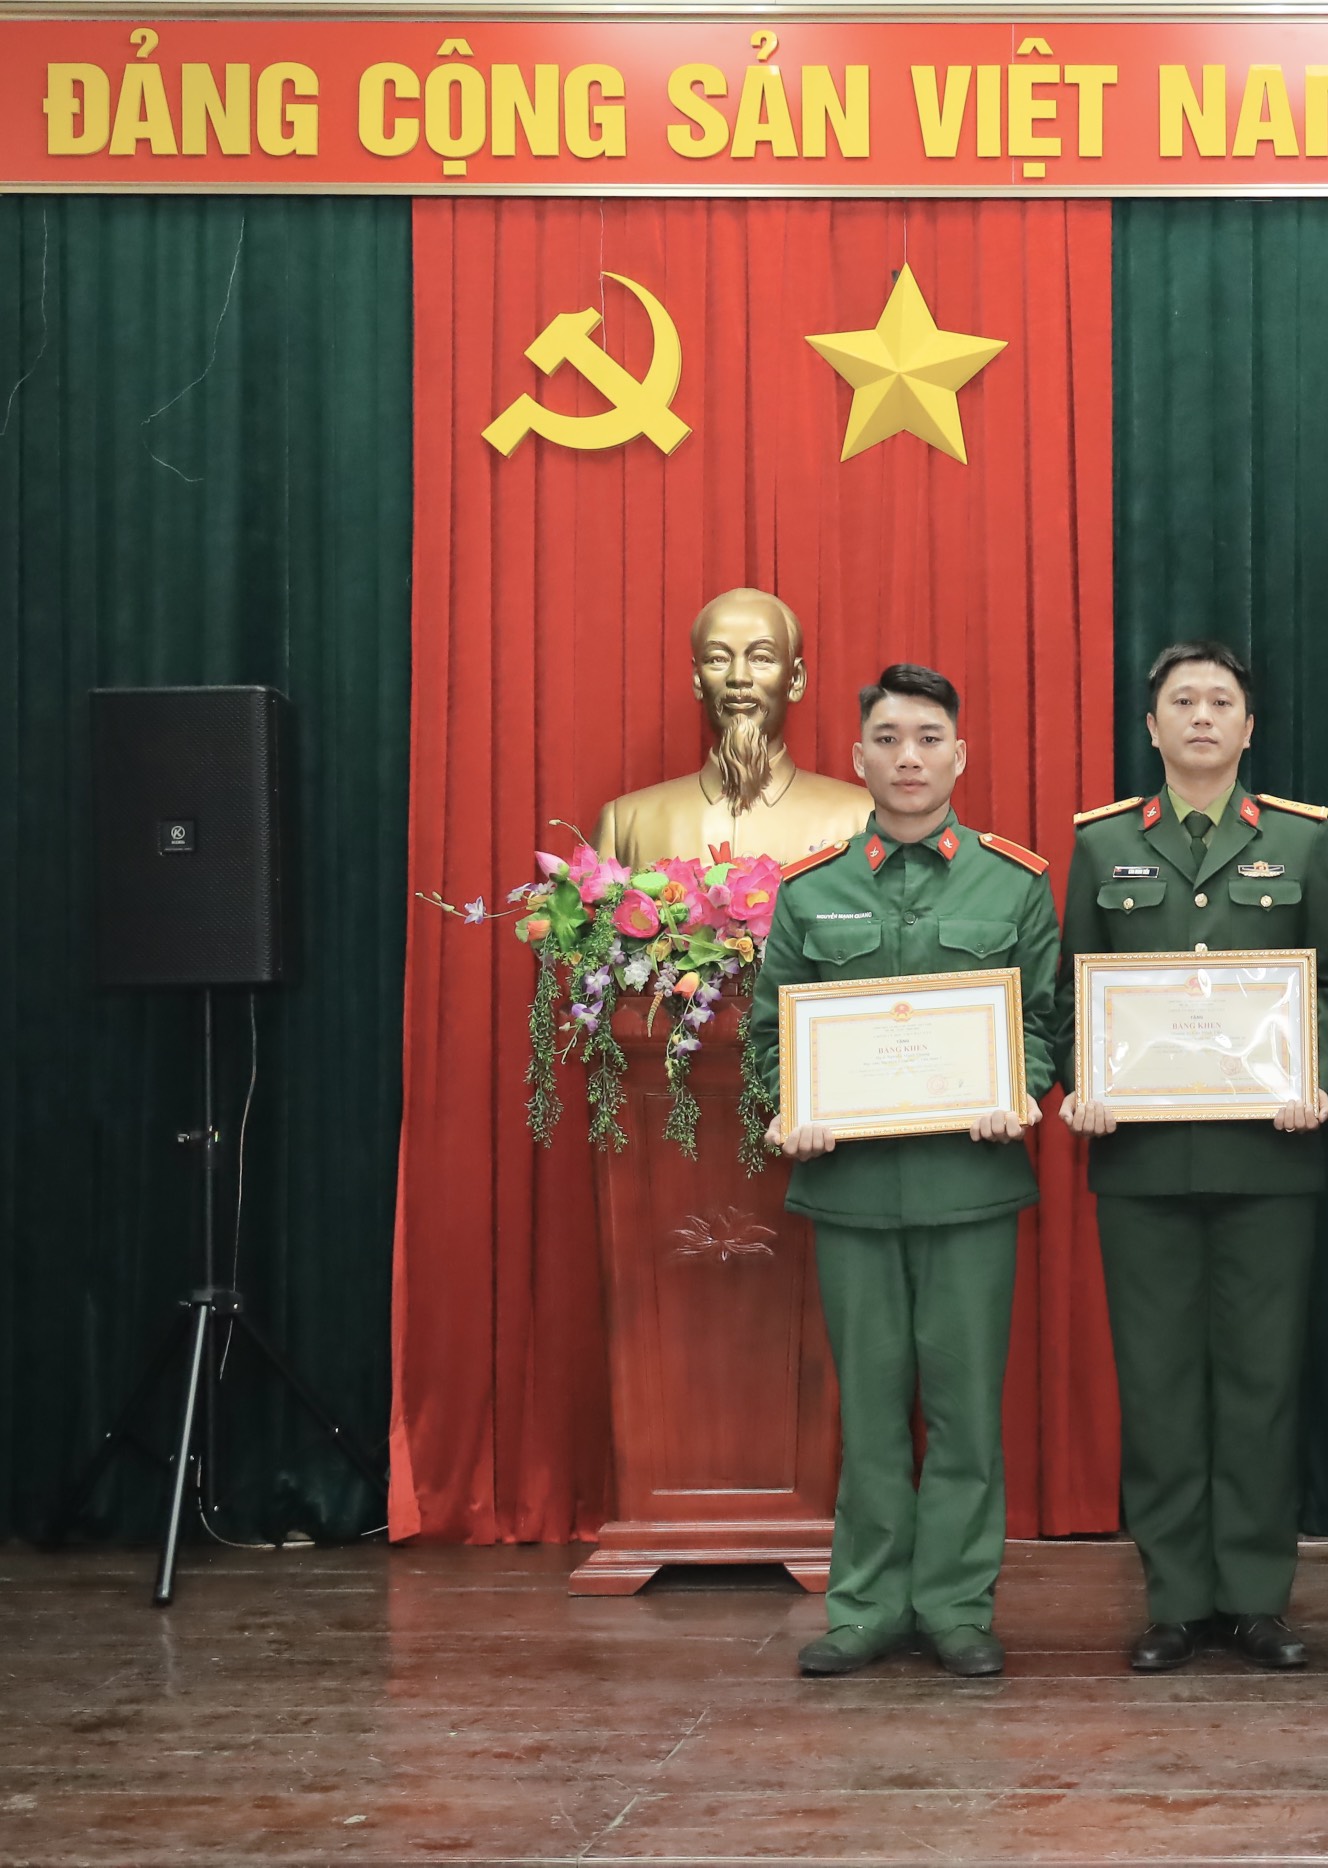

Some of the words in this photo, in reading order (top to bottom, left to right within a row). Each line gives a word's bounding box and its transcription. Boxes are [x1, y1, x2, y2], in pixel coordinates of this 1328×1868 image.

[43, 28, 320, 157] ĐẢNG
[357, 39, 628, 176] CỘNG
[666, 29, 871, 158] SẢN
[911, 38, 1118, 177] VIỆT
